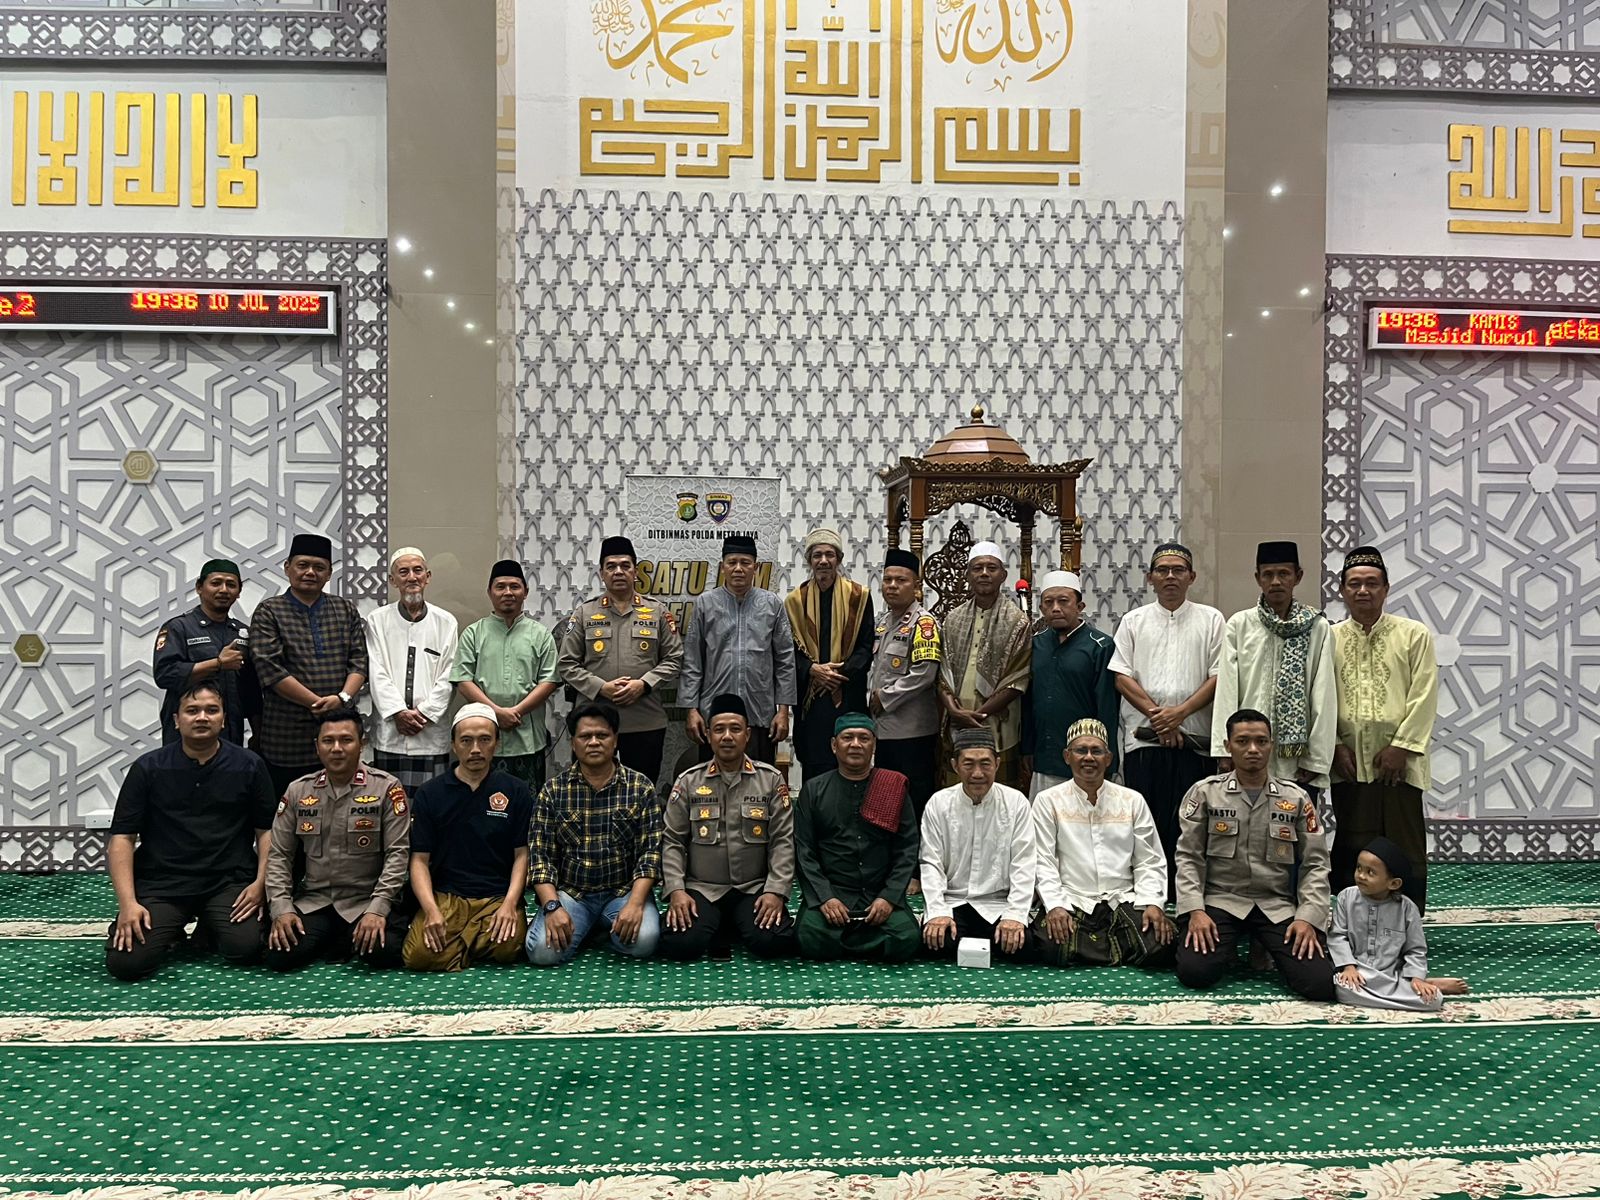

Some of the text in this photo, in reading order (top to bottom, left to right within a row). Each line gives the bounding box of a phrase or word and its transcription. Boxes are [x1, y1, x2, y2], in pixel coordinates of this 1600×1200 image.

[131, 292, 321, 312] 19:36 10 JUL 2025
[1378, 312, 1521, 330] 19:36 KAMIS
[1405, 327, 1474, 344] Masjid
[1481, 330, 1537, 346] Nurul
[648, 529, 690, 540] DITBINMAS
[691, 530, 715, 540] POLDA
[635, 561, 708, 595] SATU
[350, 806, 380, 815] POLRI
